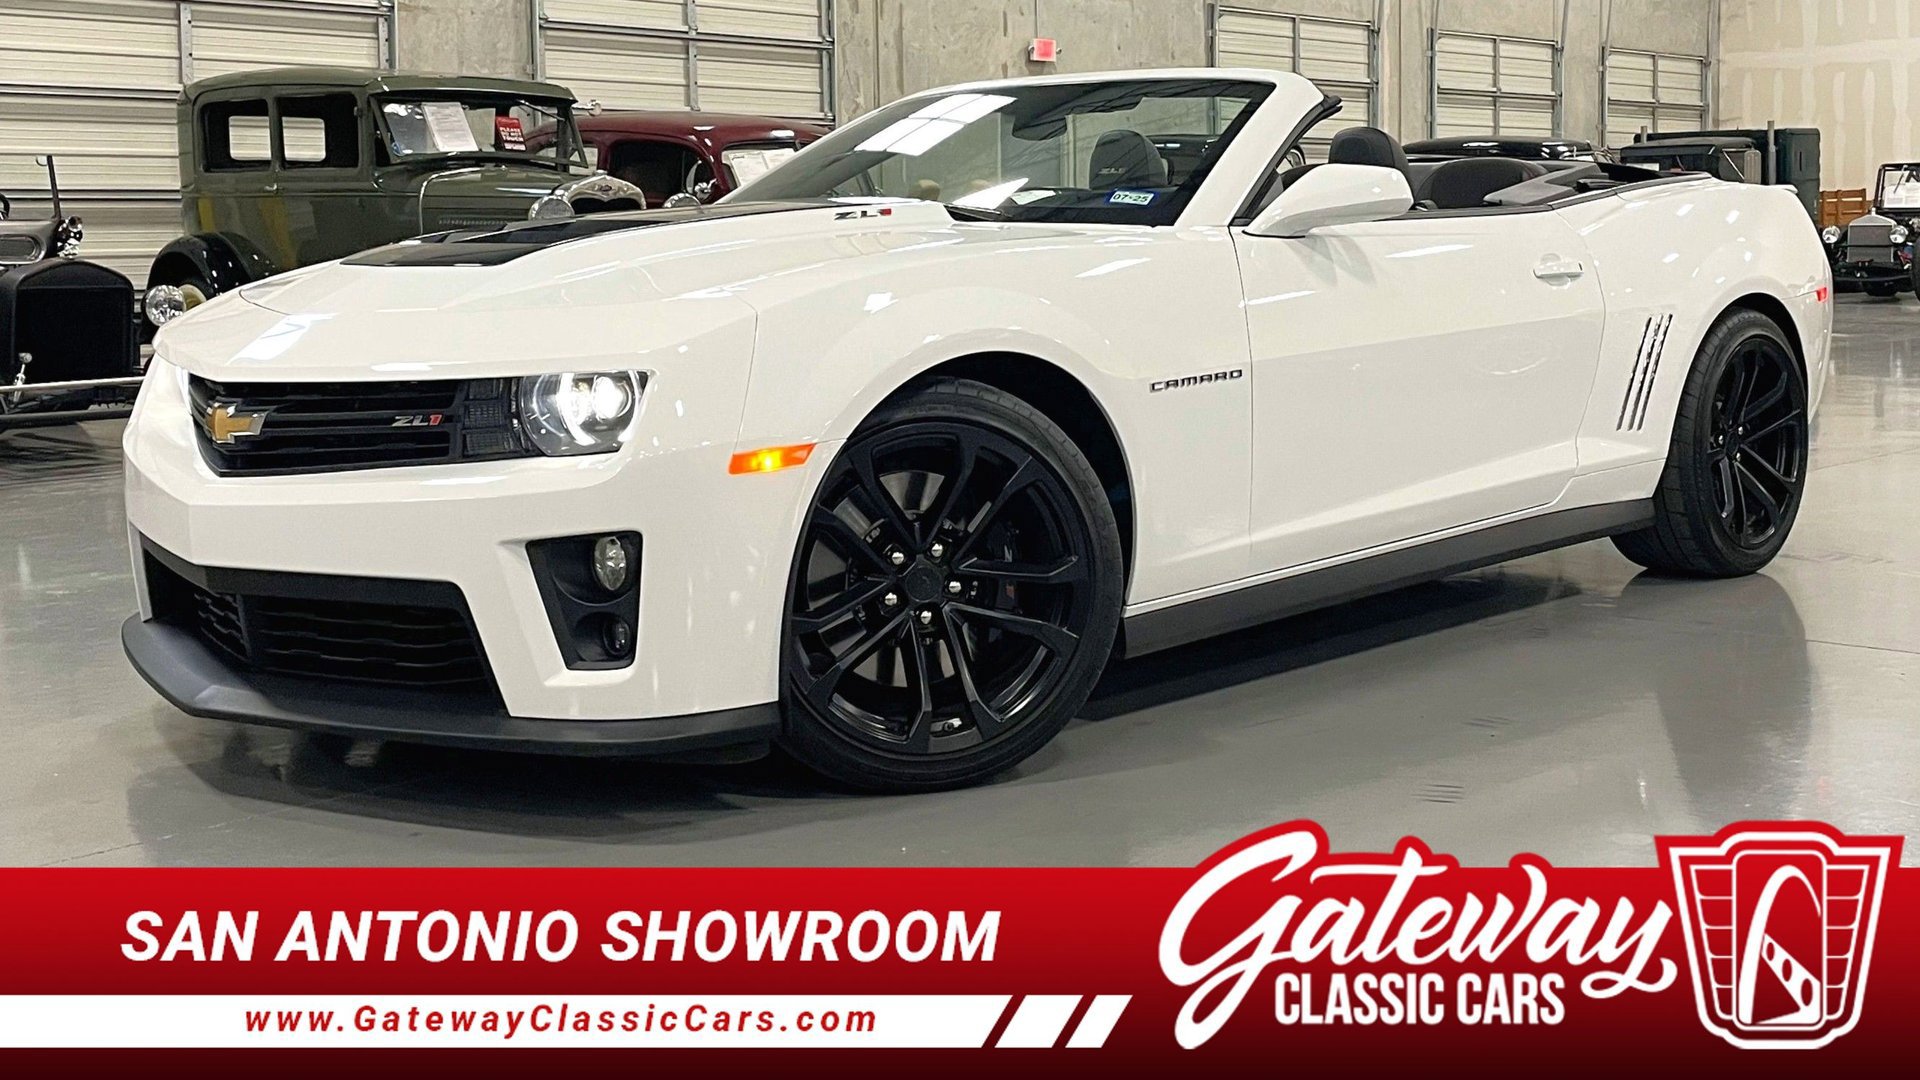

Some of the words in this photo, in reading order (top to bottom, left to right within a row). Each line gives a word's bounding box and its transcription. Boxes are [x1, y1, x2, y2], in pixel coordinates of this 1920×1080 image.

[833, 208, 892, 221] ZL1
[1149, 369, 1243, 393] CAMARO
[391, 414, 443, 427] ZL1
